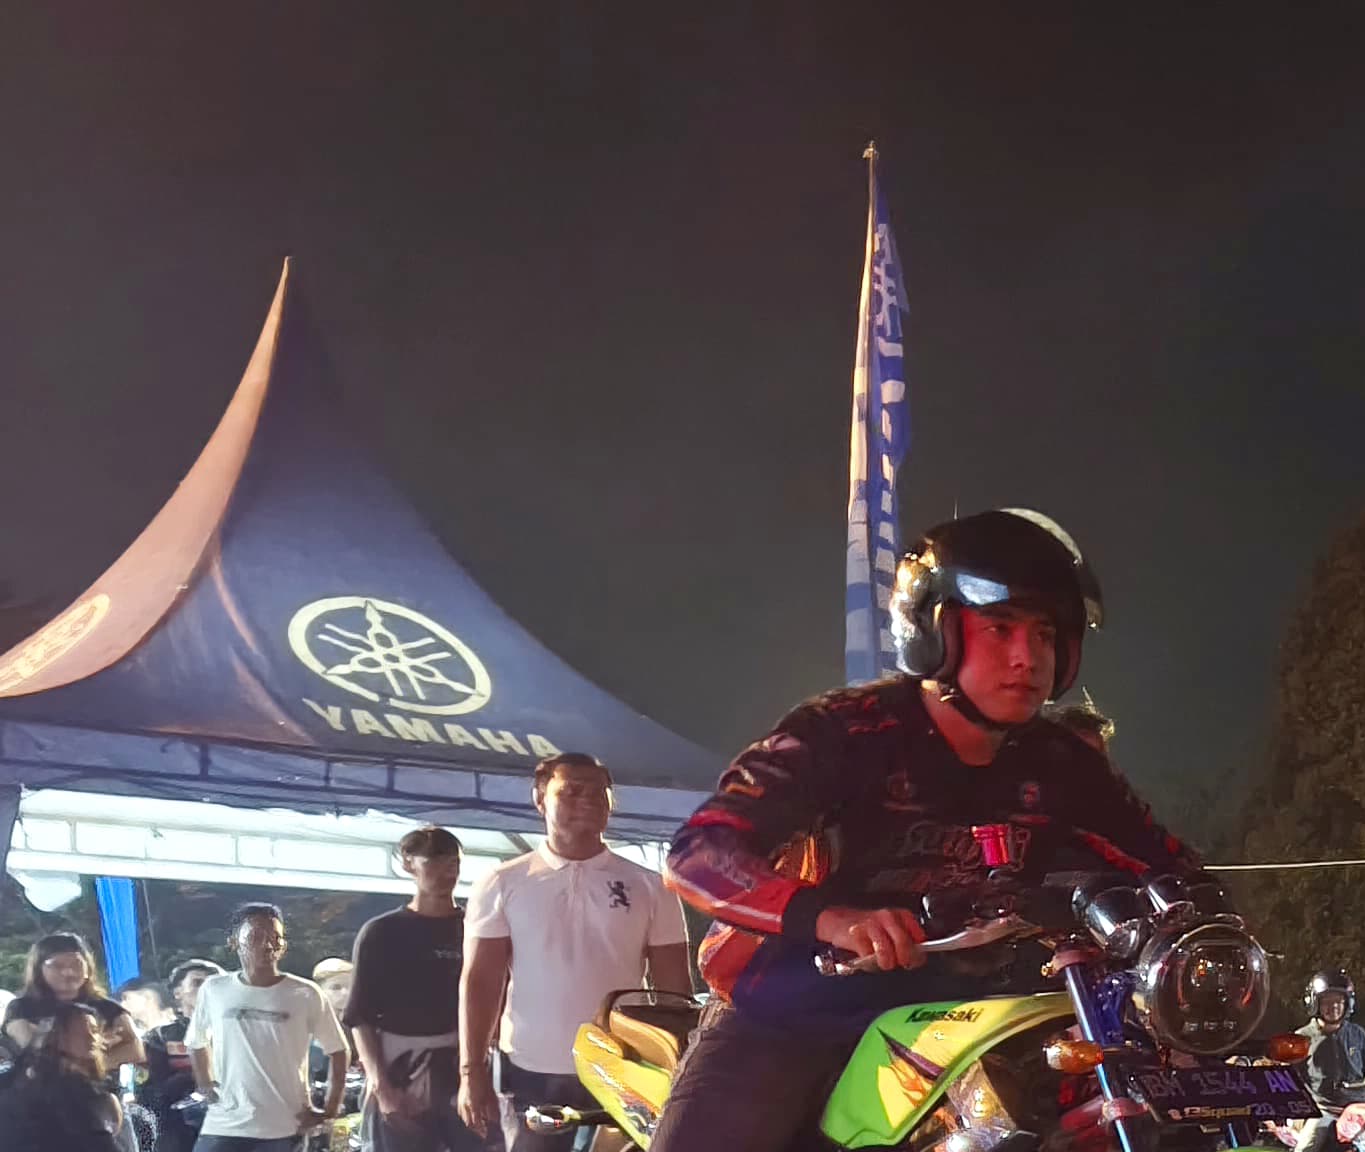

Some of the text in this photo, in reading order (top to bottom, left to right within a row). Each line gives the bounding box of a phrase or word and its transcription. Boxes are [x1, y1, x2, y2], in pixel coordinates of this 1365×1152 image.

[302, 698, 563, 759] YAMAHA
[905, 1007, 985, 1024] Kawasaki
[1264, 1069, 1300, 1093] AN
